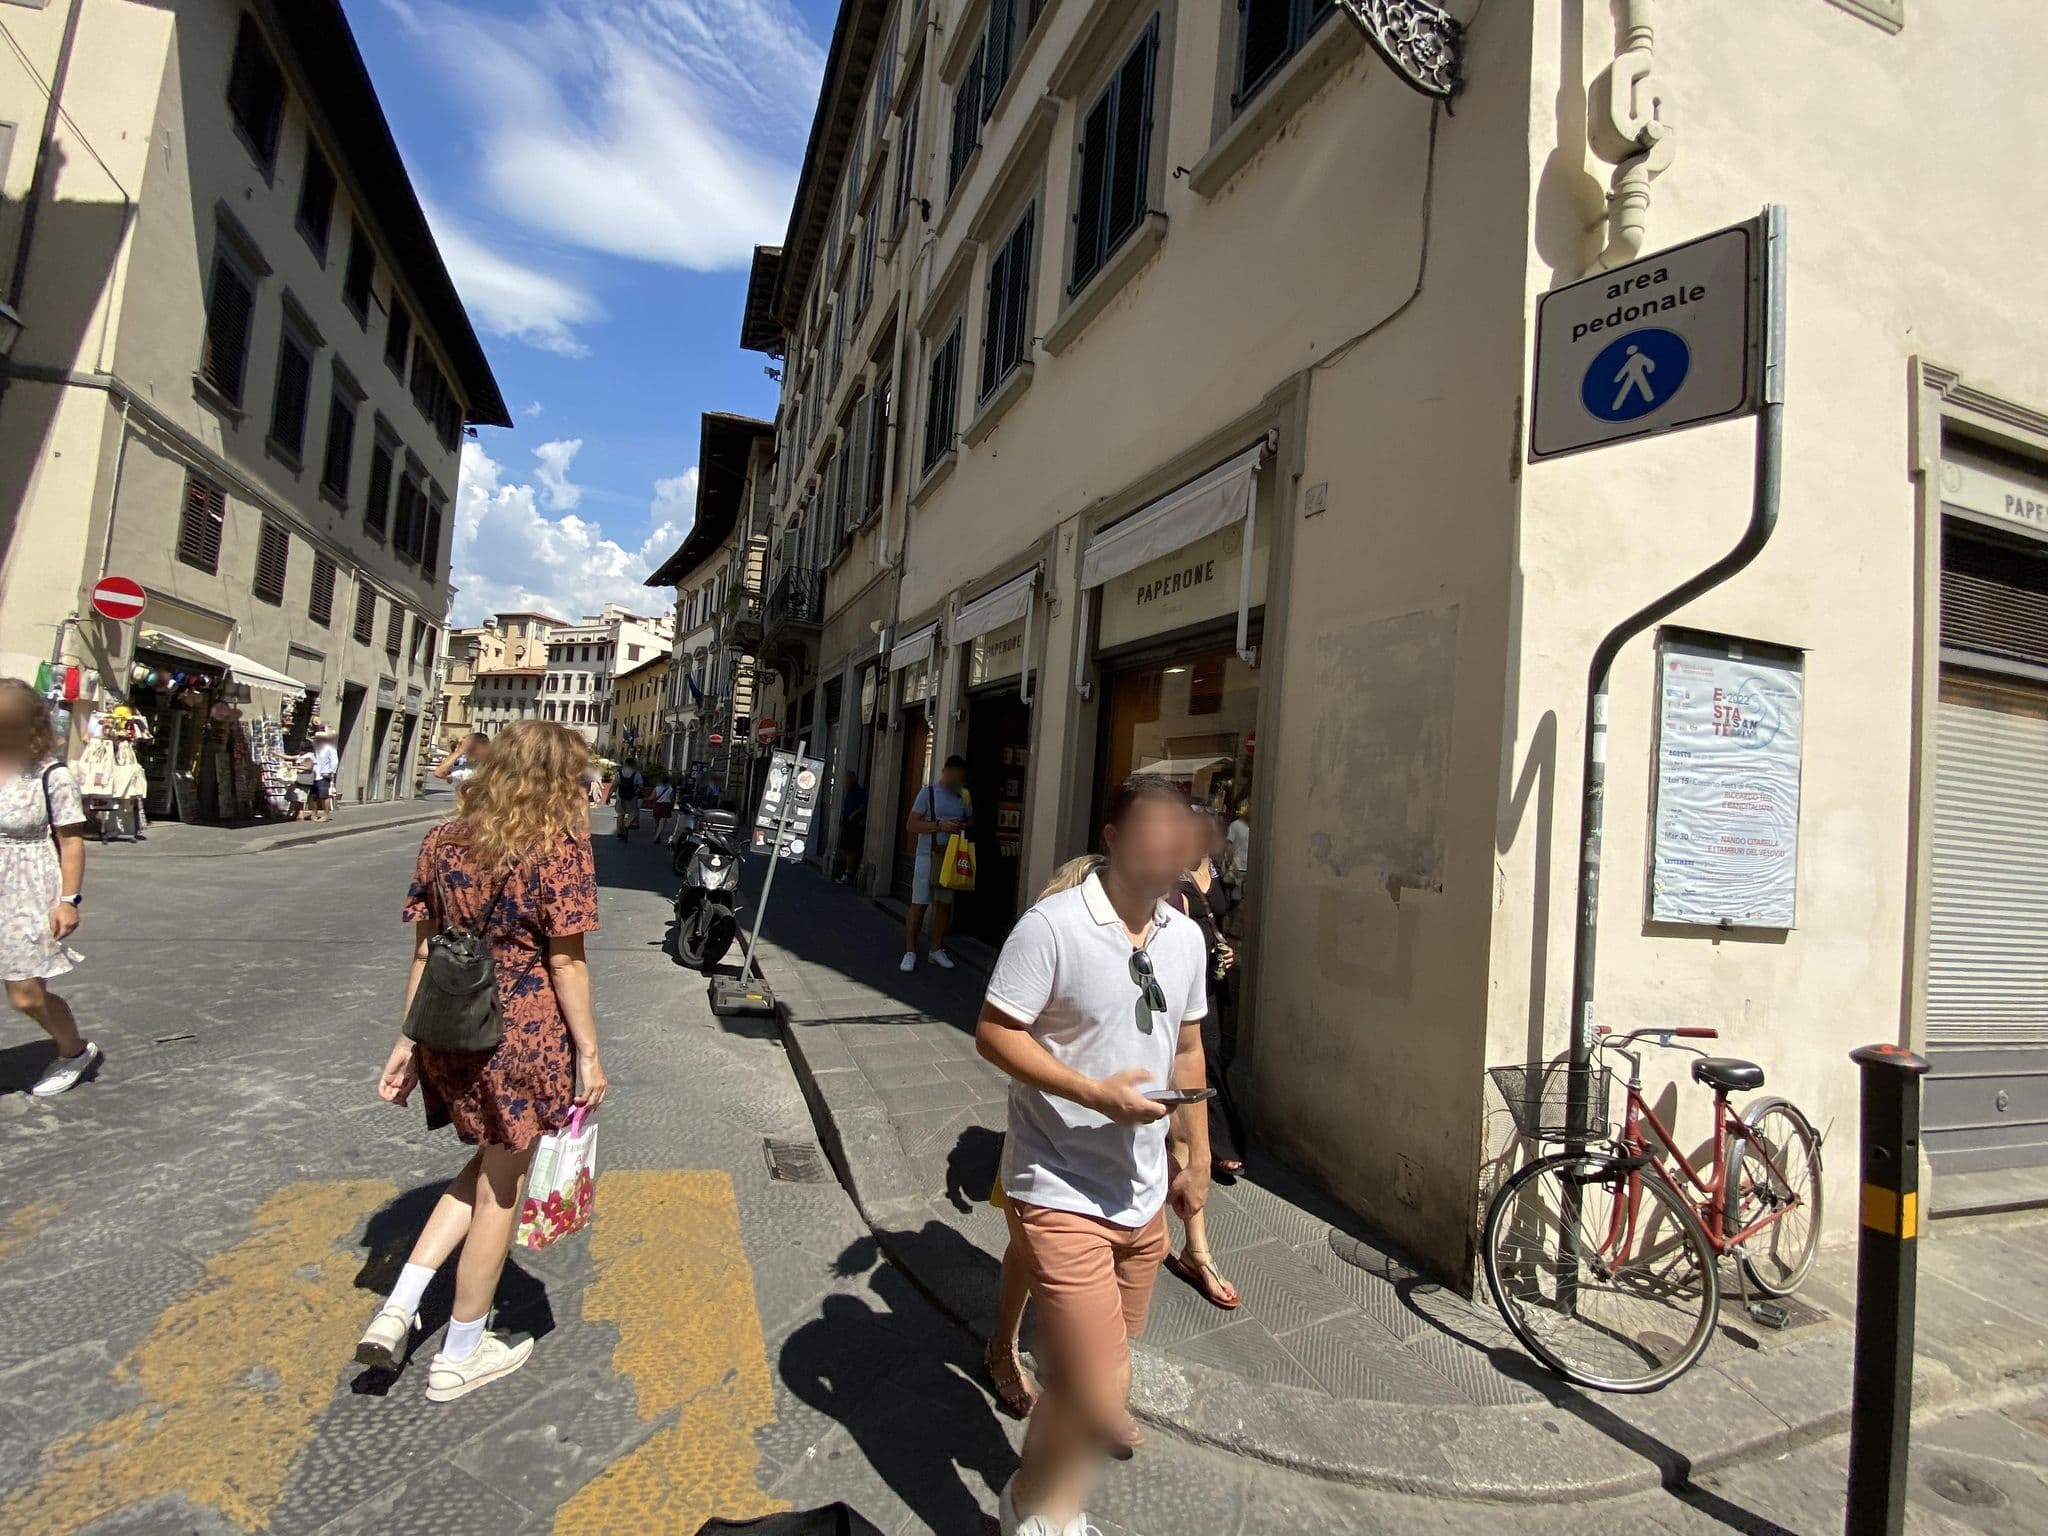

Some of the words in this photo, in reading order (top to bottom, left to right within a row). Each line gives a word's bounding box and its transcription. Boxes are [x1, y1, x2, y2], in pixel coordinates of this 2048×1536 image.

[1606, 266, 1668, 300] area
[1571, 284, 1706, 343] pedonale
[2005, 494, 2048, 524] PAPE
[1136, 559, 1215, 606] PAPERONE
[1713, 704, 1742, 721] STA
[1727, 692, 1750, 706] 2022
[1720, 836, 1746, 845] NANDO
